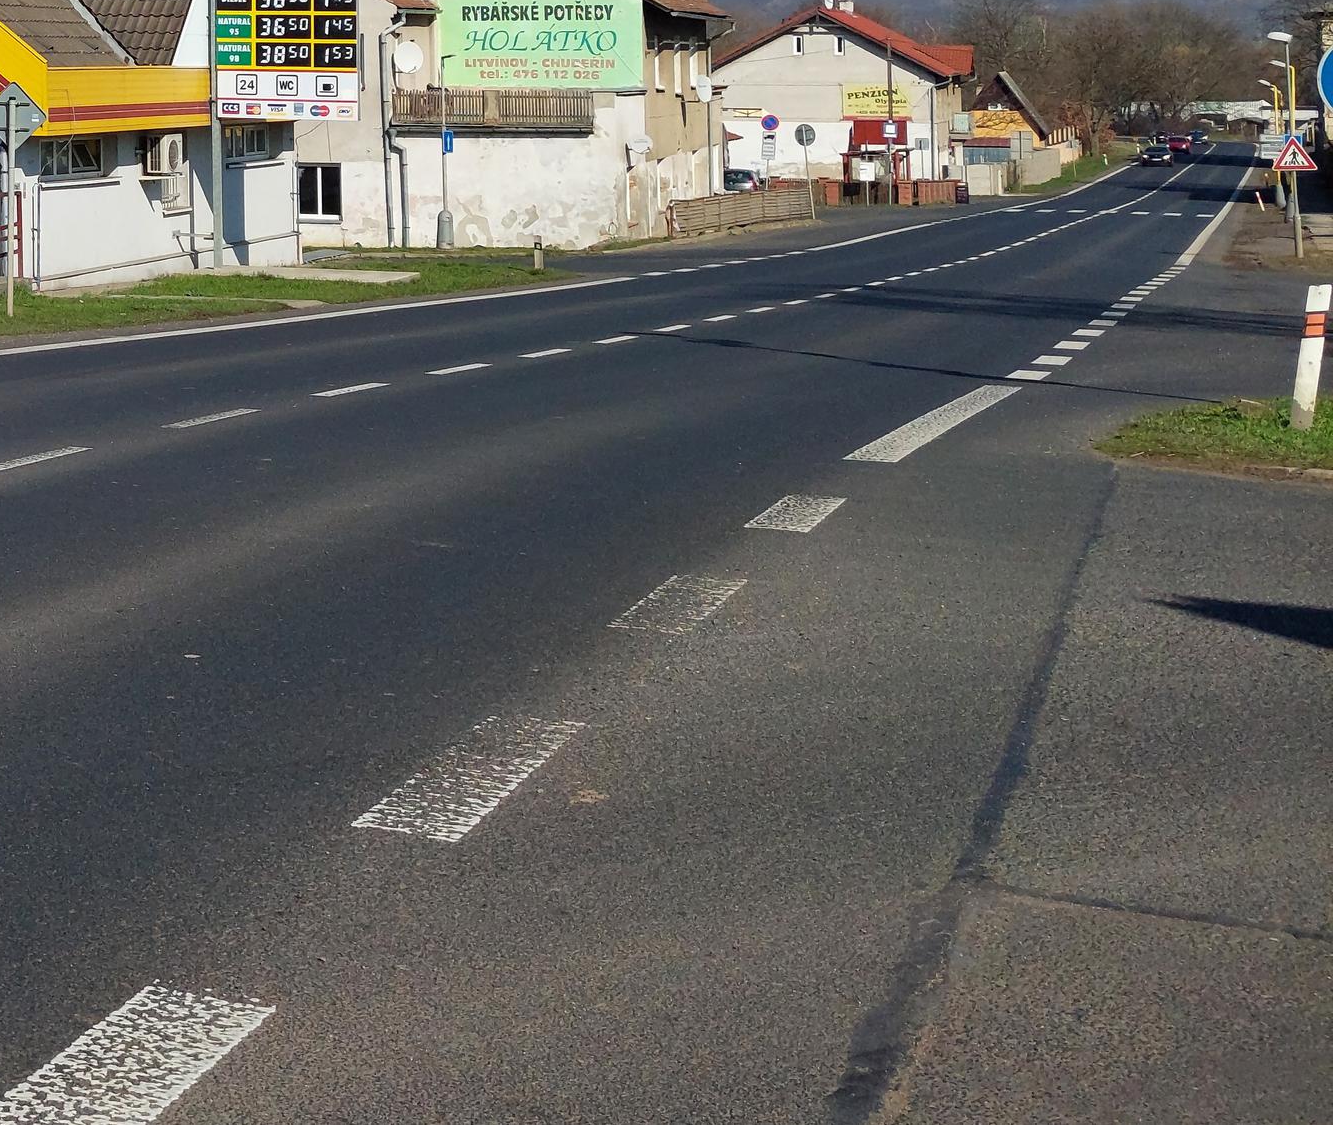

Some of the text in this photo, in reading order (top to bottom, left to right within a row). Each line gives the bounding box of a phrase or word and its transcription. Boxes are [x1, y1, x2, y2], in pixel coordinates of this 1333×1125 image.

[462, 1, 539, 21] RYBÁŘSKÉ
[217, 17, 251, 25] NATURAL
[229, 28, 240, 36] 95
[464, 24, 617, 55] HOLÁTKO
[217, 44, 251, 52] NATURAL
[229, 55, 240, 63] 98
[479, 69, 600, 80] tel.: 476 112 026
[239, 79, 295, 91] 24 WC
[223, 104, 239, 112] CCS
